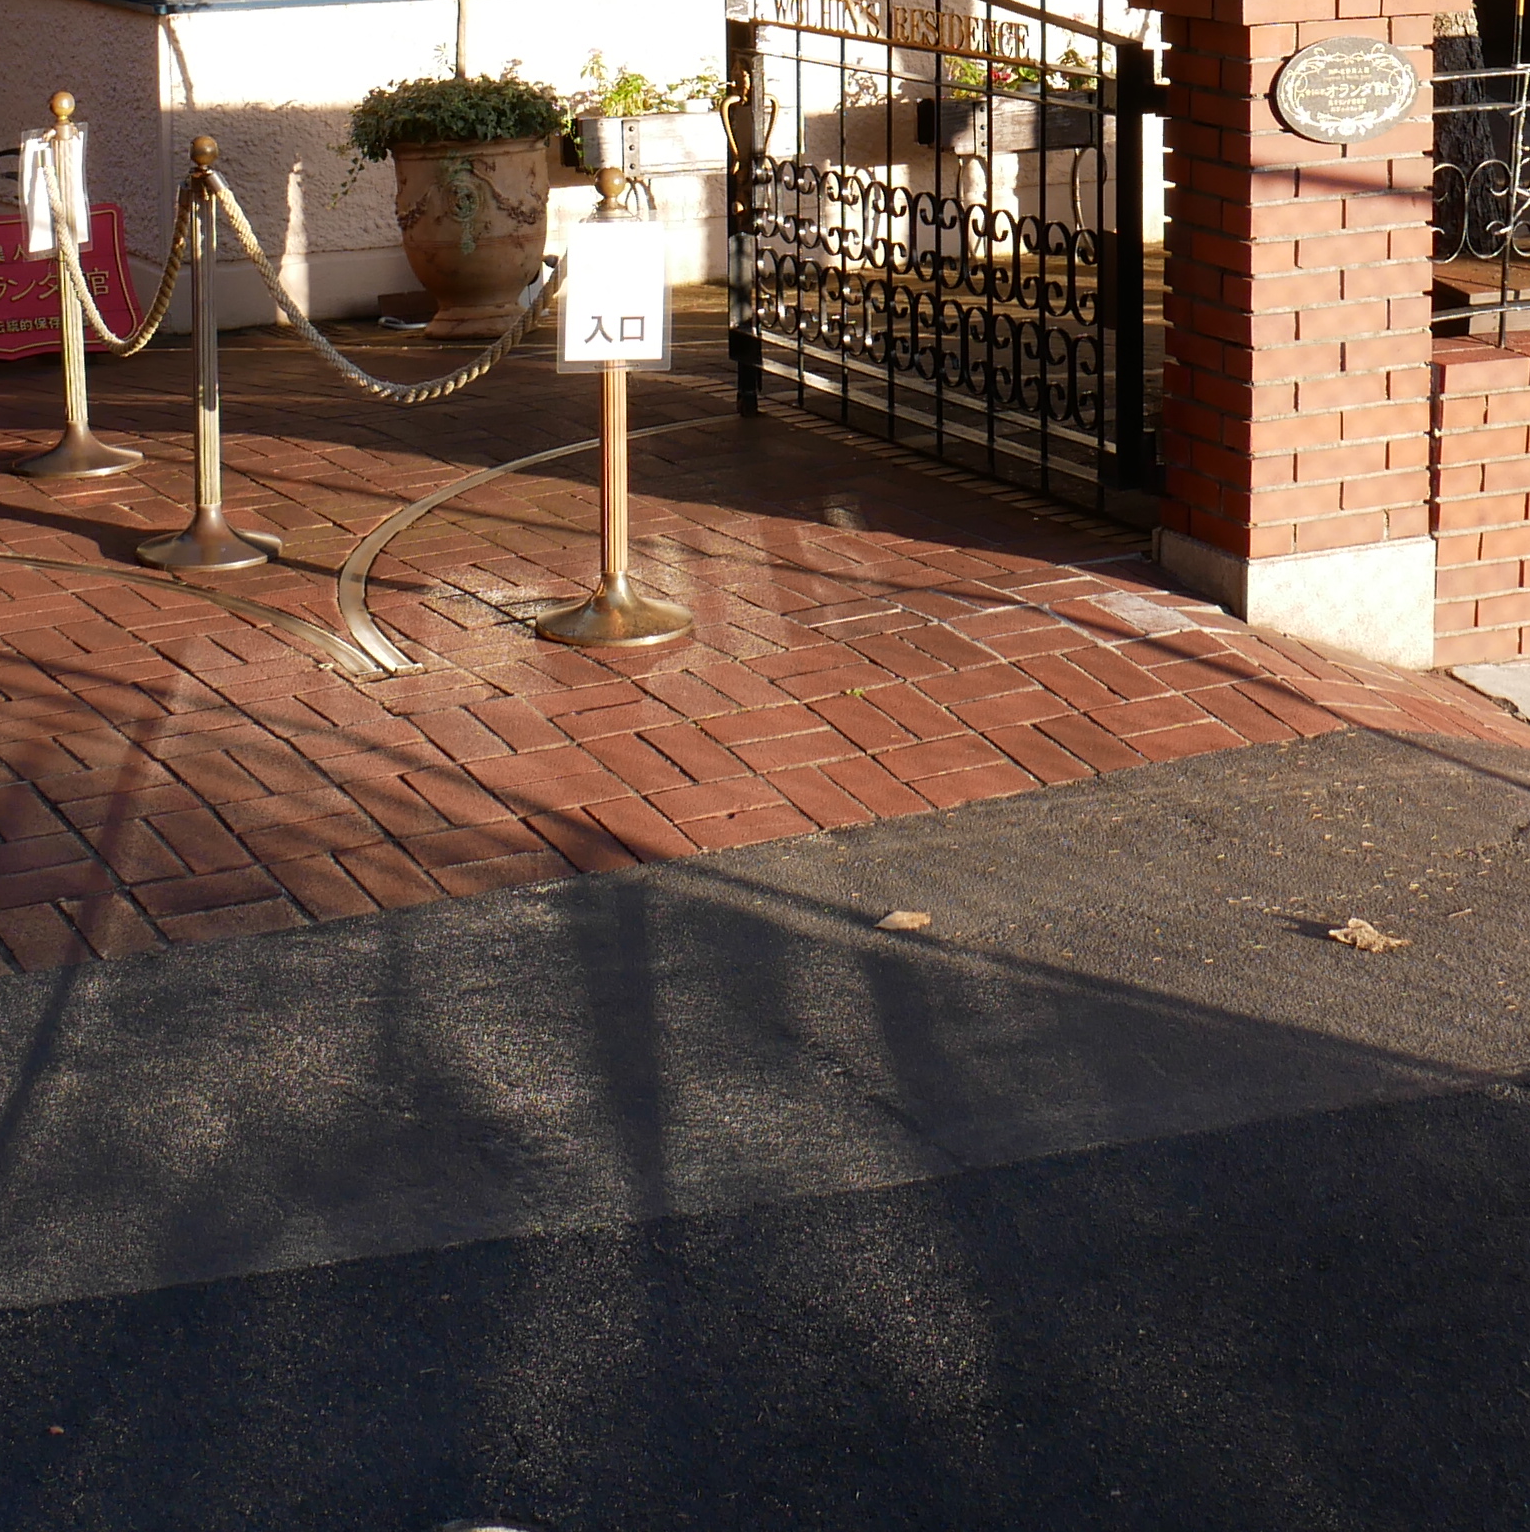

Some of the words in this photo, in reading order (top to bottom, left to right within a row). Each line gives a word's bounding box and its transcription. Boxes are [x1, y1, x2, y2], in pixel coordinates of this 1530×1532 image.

[1325, 80, 1390, 99] オランダ館
[584, 315, 646, 344] 入口
